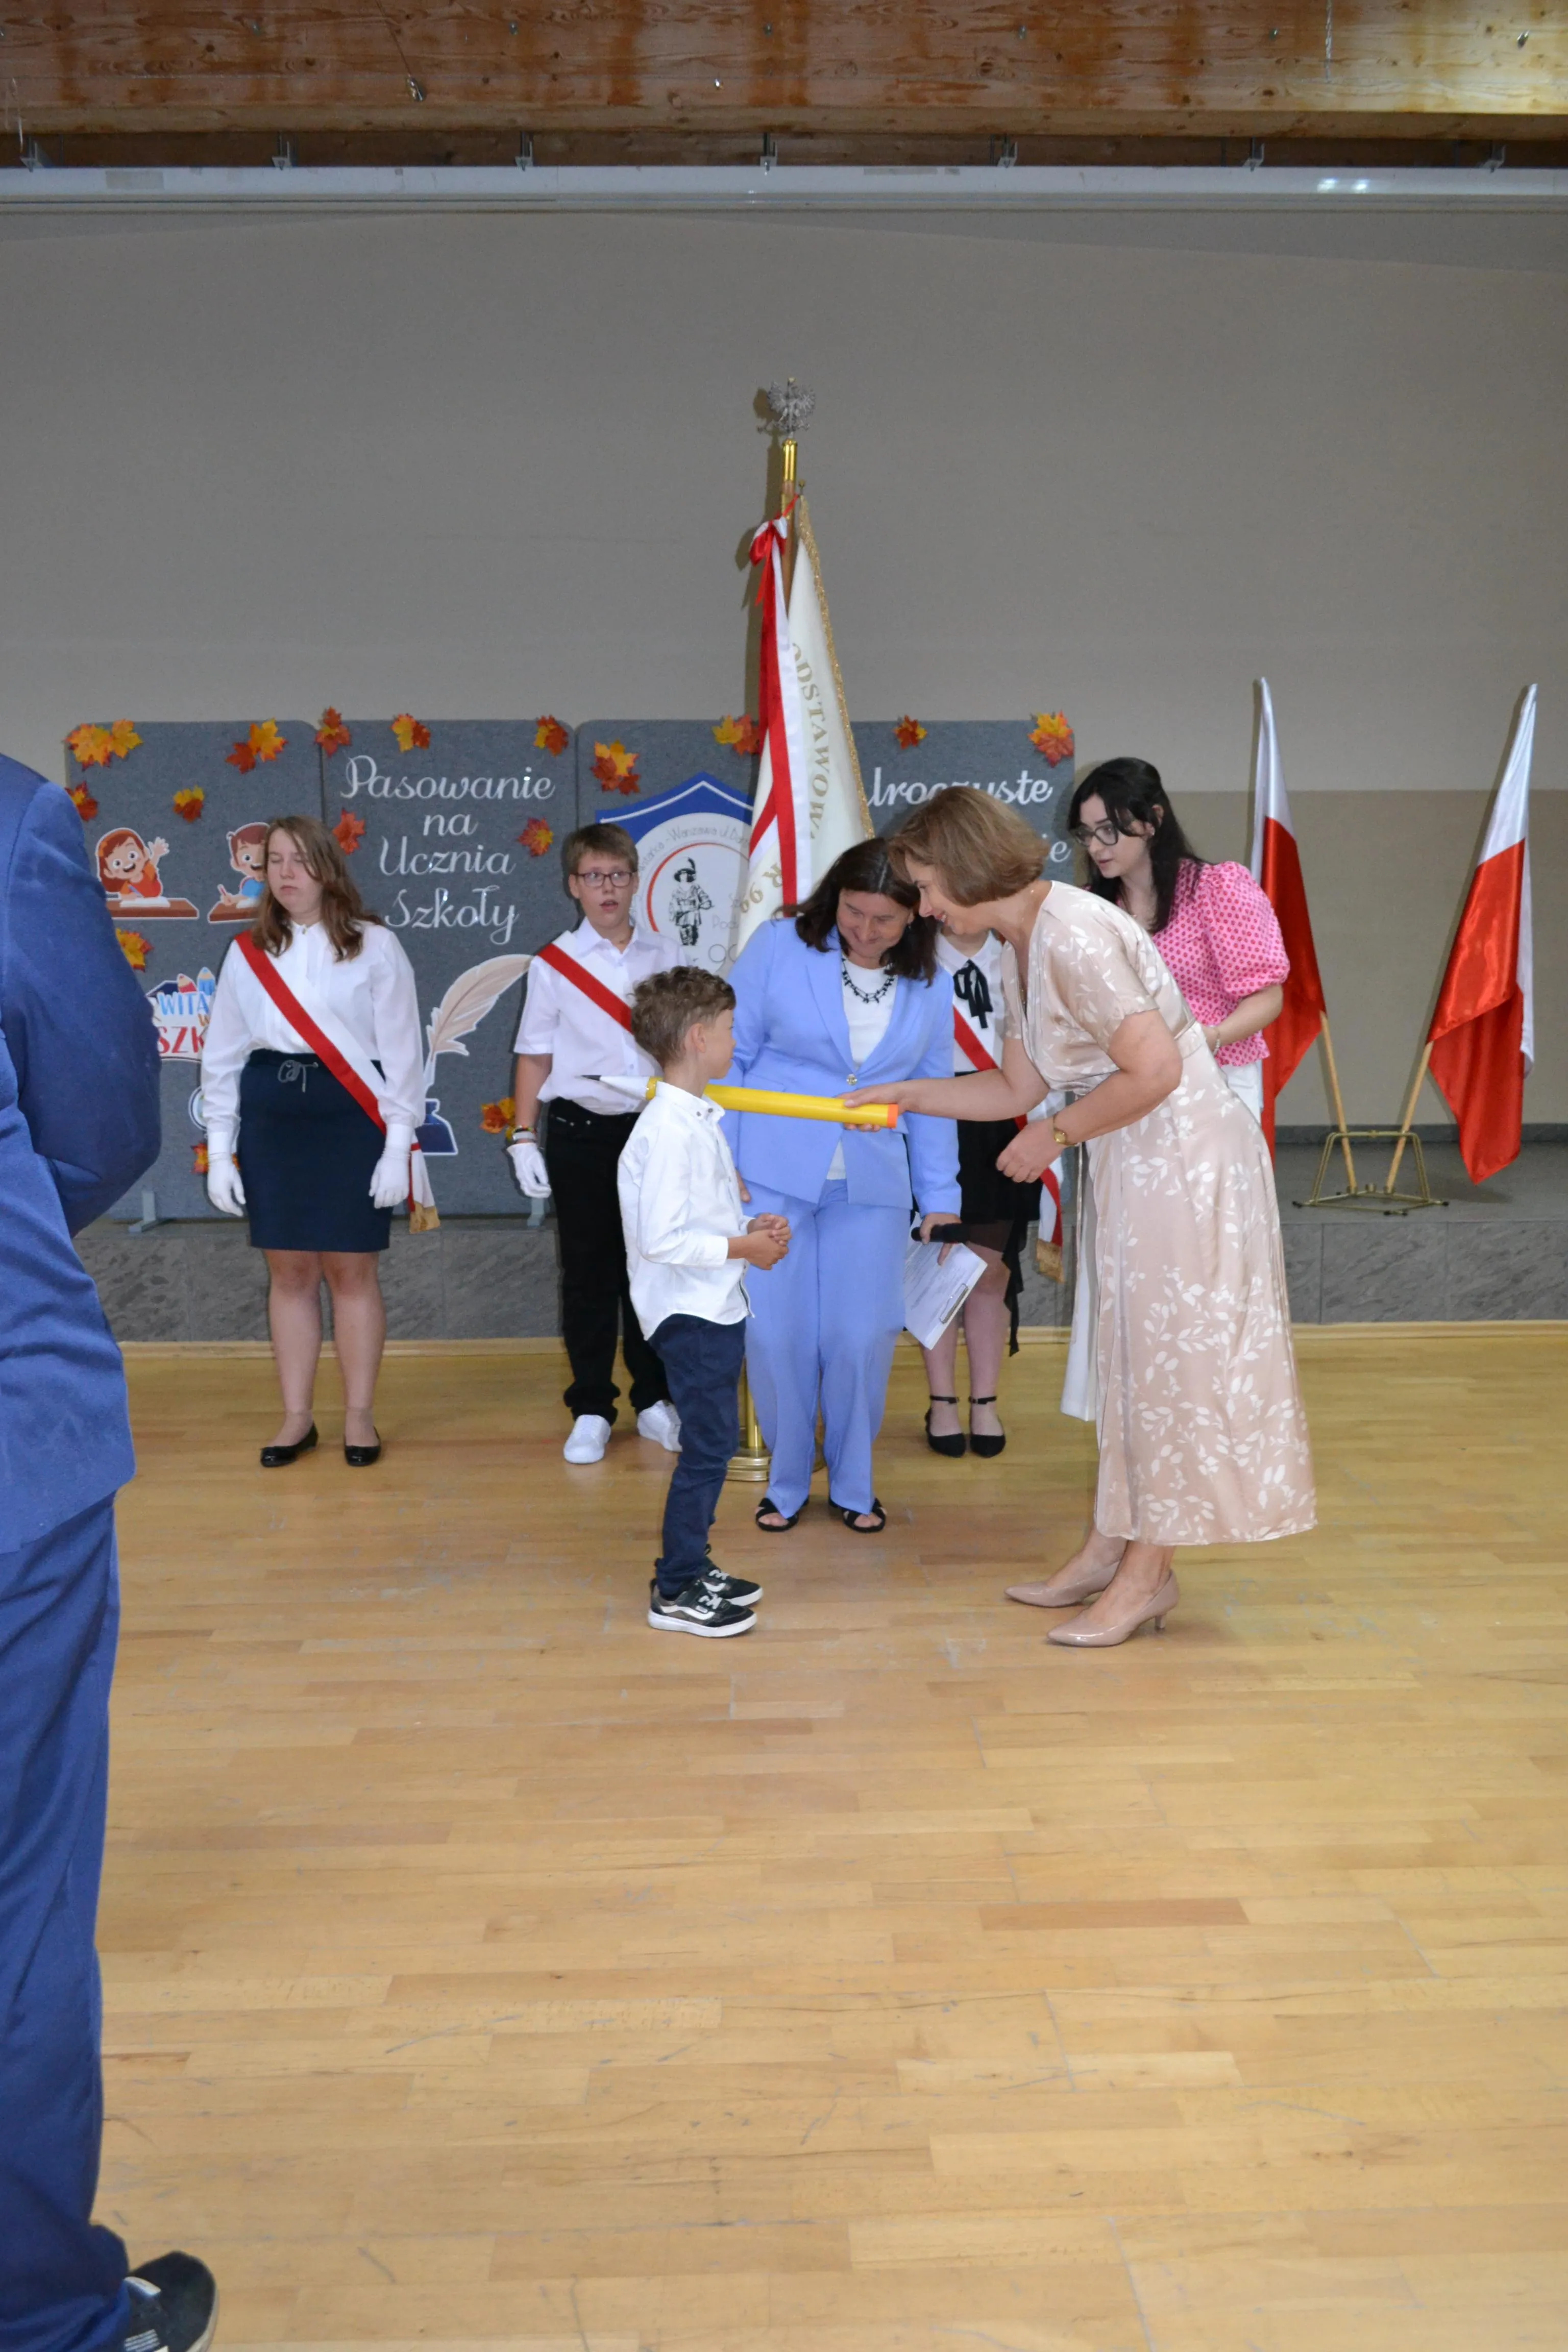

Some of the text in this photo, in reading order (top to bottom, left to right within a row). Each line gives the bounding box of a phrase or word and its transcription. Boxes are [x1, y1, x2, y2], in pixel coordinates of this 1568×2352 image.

[340, 755, 555, 799] Pasowanie
[423, 814, 478, 837] na
[379, 835, 516, 876] Ucznia
[385, 885, 519, 945] Szkoły
[157, 993, 210, 1016] WITA
[157, 1026, 204, 1054] SZK
